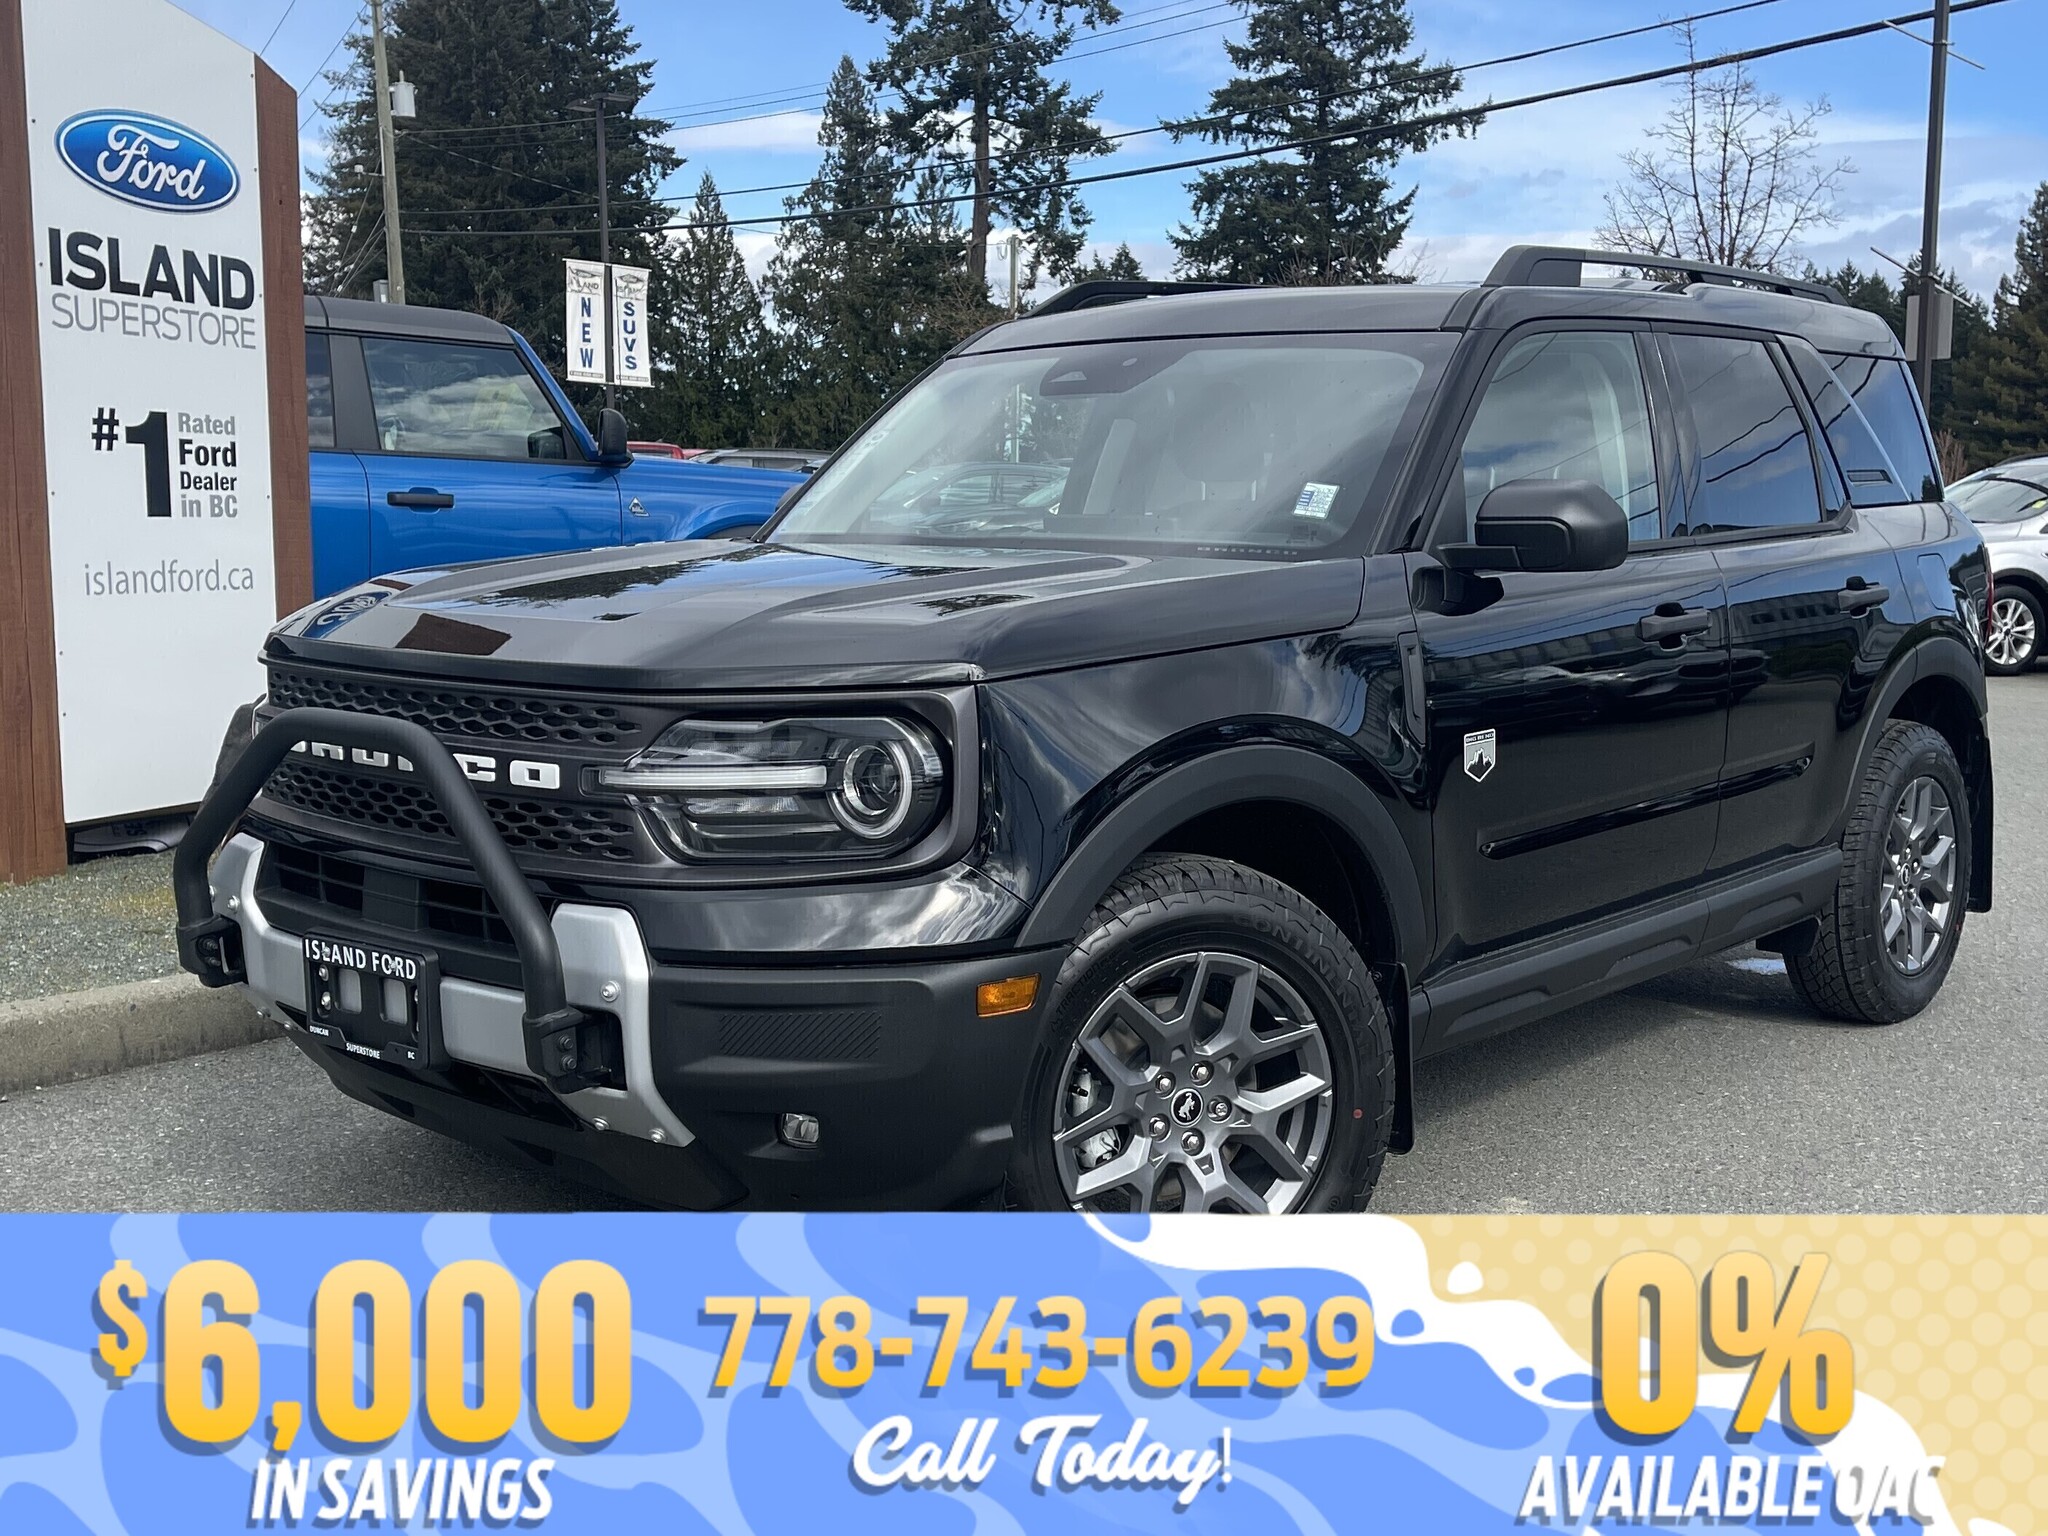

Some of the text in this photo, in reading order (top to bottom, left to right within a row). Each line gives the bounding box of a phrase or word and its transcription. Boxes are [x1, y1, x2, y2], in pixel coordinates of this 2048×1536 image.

[96, 124, 207, 201] Ford
[48, 226, 255, 311] ISLAND
[51, 292, 257, 350] SUPERSTORE
[580, 296, 594, 369] NEW
[623, 301, 638, 370] SUVS
[177, 411, 236, 436] Rated
[91, 406, 172, 518] #1
[178, 438, 237, 468] Ford
[179, 470, 238, 492] Dealer
[180, 494, 238, 518] in BC
[84, 558, 254, 596] islandford.ca
[304, 938, 416, 980] ISLAND FORD
[345, 1042, 381, 1060] SUPERSTORE
[407, 1051, 416, 1060] BC
